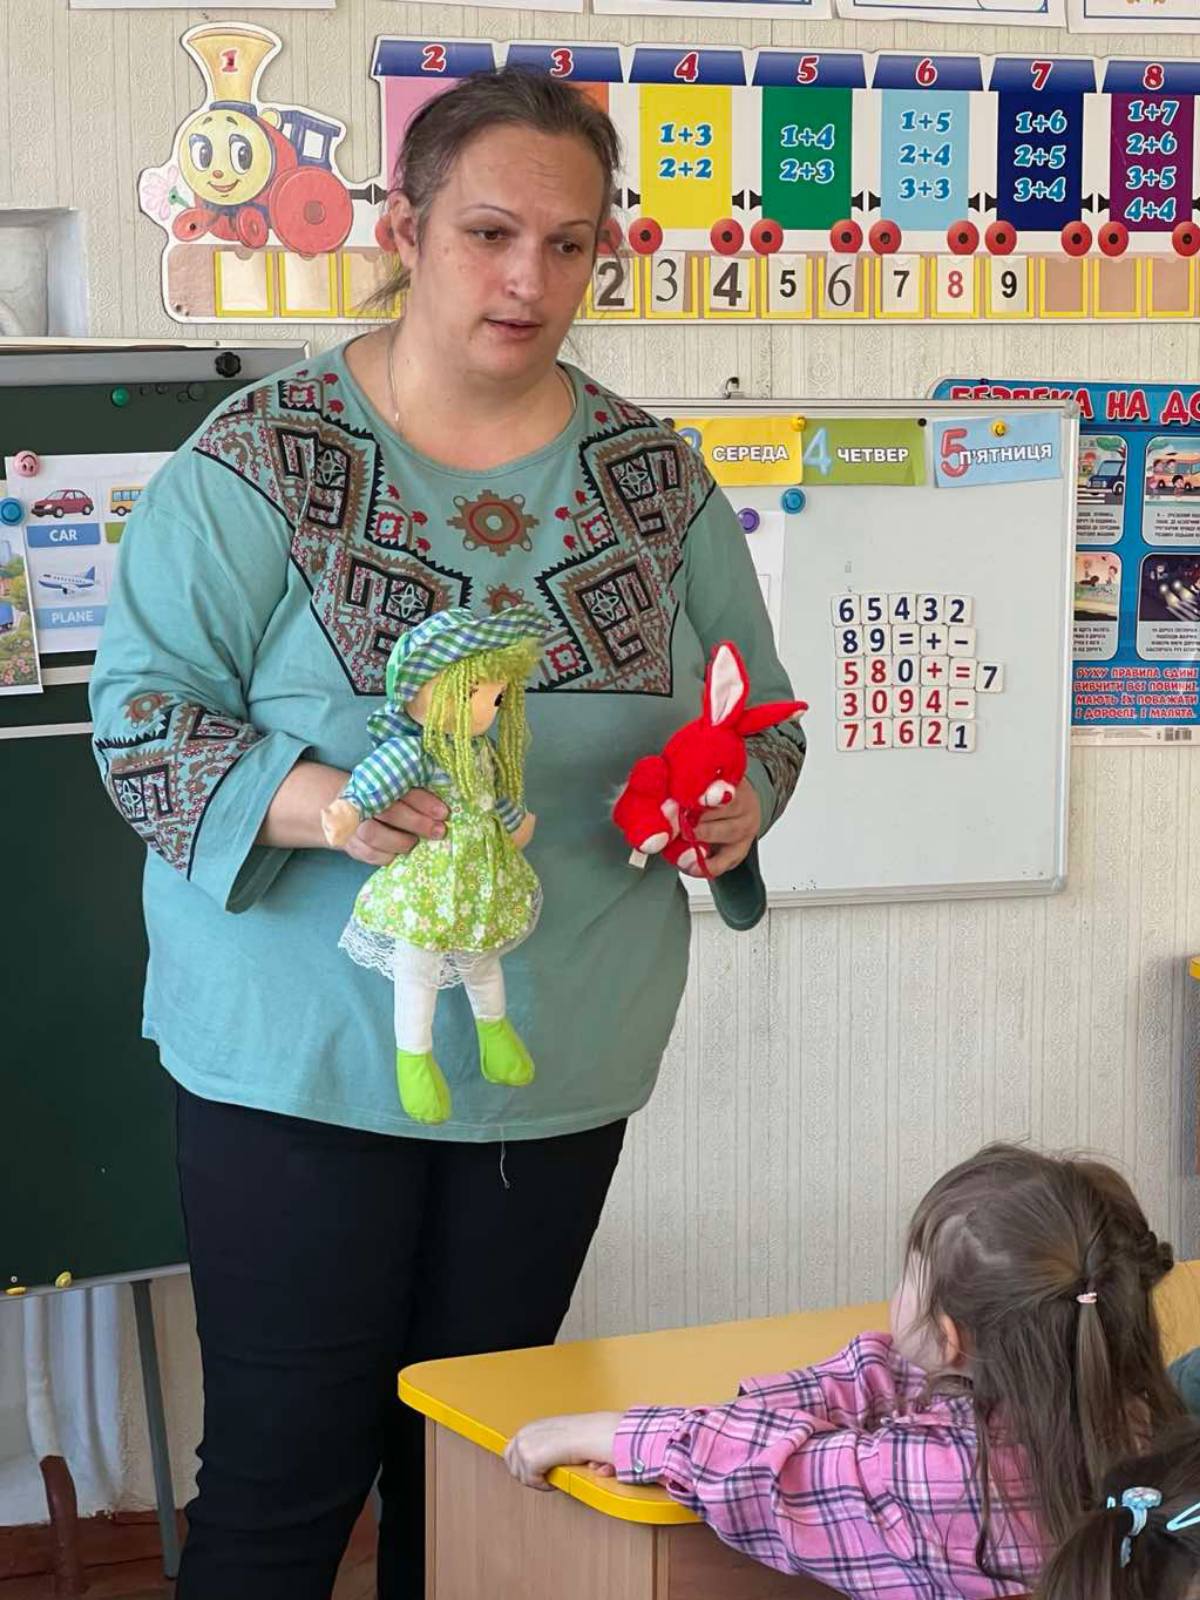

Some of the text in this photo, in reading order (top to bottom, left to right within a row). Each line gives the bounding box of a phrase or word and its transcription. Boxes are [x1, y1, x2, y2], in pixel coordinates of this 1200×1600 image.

[221, 49, 239, 73] 1
[421, 45, 446, 71] 2
[550, 48, 574, 77] 3
[674, 51, 700, 82] 4
[796, 55, 819, 83] 5
[915, 58, 938, 86] 6
[1031, 61, 1054, 91] 7
[1142, 63, 1164, 89] 8
[900, 110, 951, 133] 1+5
[1015, 111, 1067, 135] 1+6
[1128, 100, 1179, 125] 1+7
[659, 123, 713, 146] 1+3
[780, 123, 835, 148] 1+4
[1126, 133, 1177, 155] 2+6
[898, 143, 951, 166] 2+4
[1013, 145, 1066, 169] 2+5
[658, 157, 713, 180] 2+2
[779, 158, 834, 182] 2+3
[1125, 165, 1176, 190] 3+5
[899, 176, 950, 200] 3+3
[1013, 177, 1066, 202] 3+4
[1124, 197, 1176, 222] 4+4
[597, 258, 1017, 306] 2 3 4 5 6 7 8 9
[1107, 390, 1149, 419] НА
[712, 445, 789, 463] СЕРЕДА
[803, 427, 909, 476] 4 ЧЕТВЕР
[940, 427, 1053, 477] 5 П'ЯТНИЦЯ
[49, 529, 78, 542] CAR
[51, 610, 94, 623] PLANE
[839, 597, 964, 622] 6 5 4 3 2
[843, 630, 858, 653] 8
[870, 628, 884, 652] 9
[844, 662, 858, 685] 5
[871, 659, 886, 683] 8
[898, 659, 913, 682] 0
[983, 666, 997, 688] 7
[844, 692, 857, 716] 3
[872, 690, 887, 713] 0
[899, 689, 913, 712] 9
[927, 690, 941, 713] 4
[844, 720, 967, 748] 7 1 6 2 1
